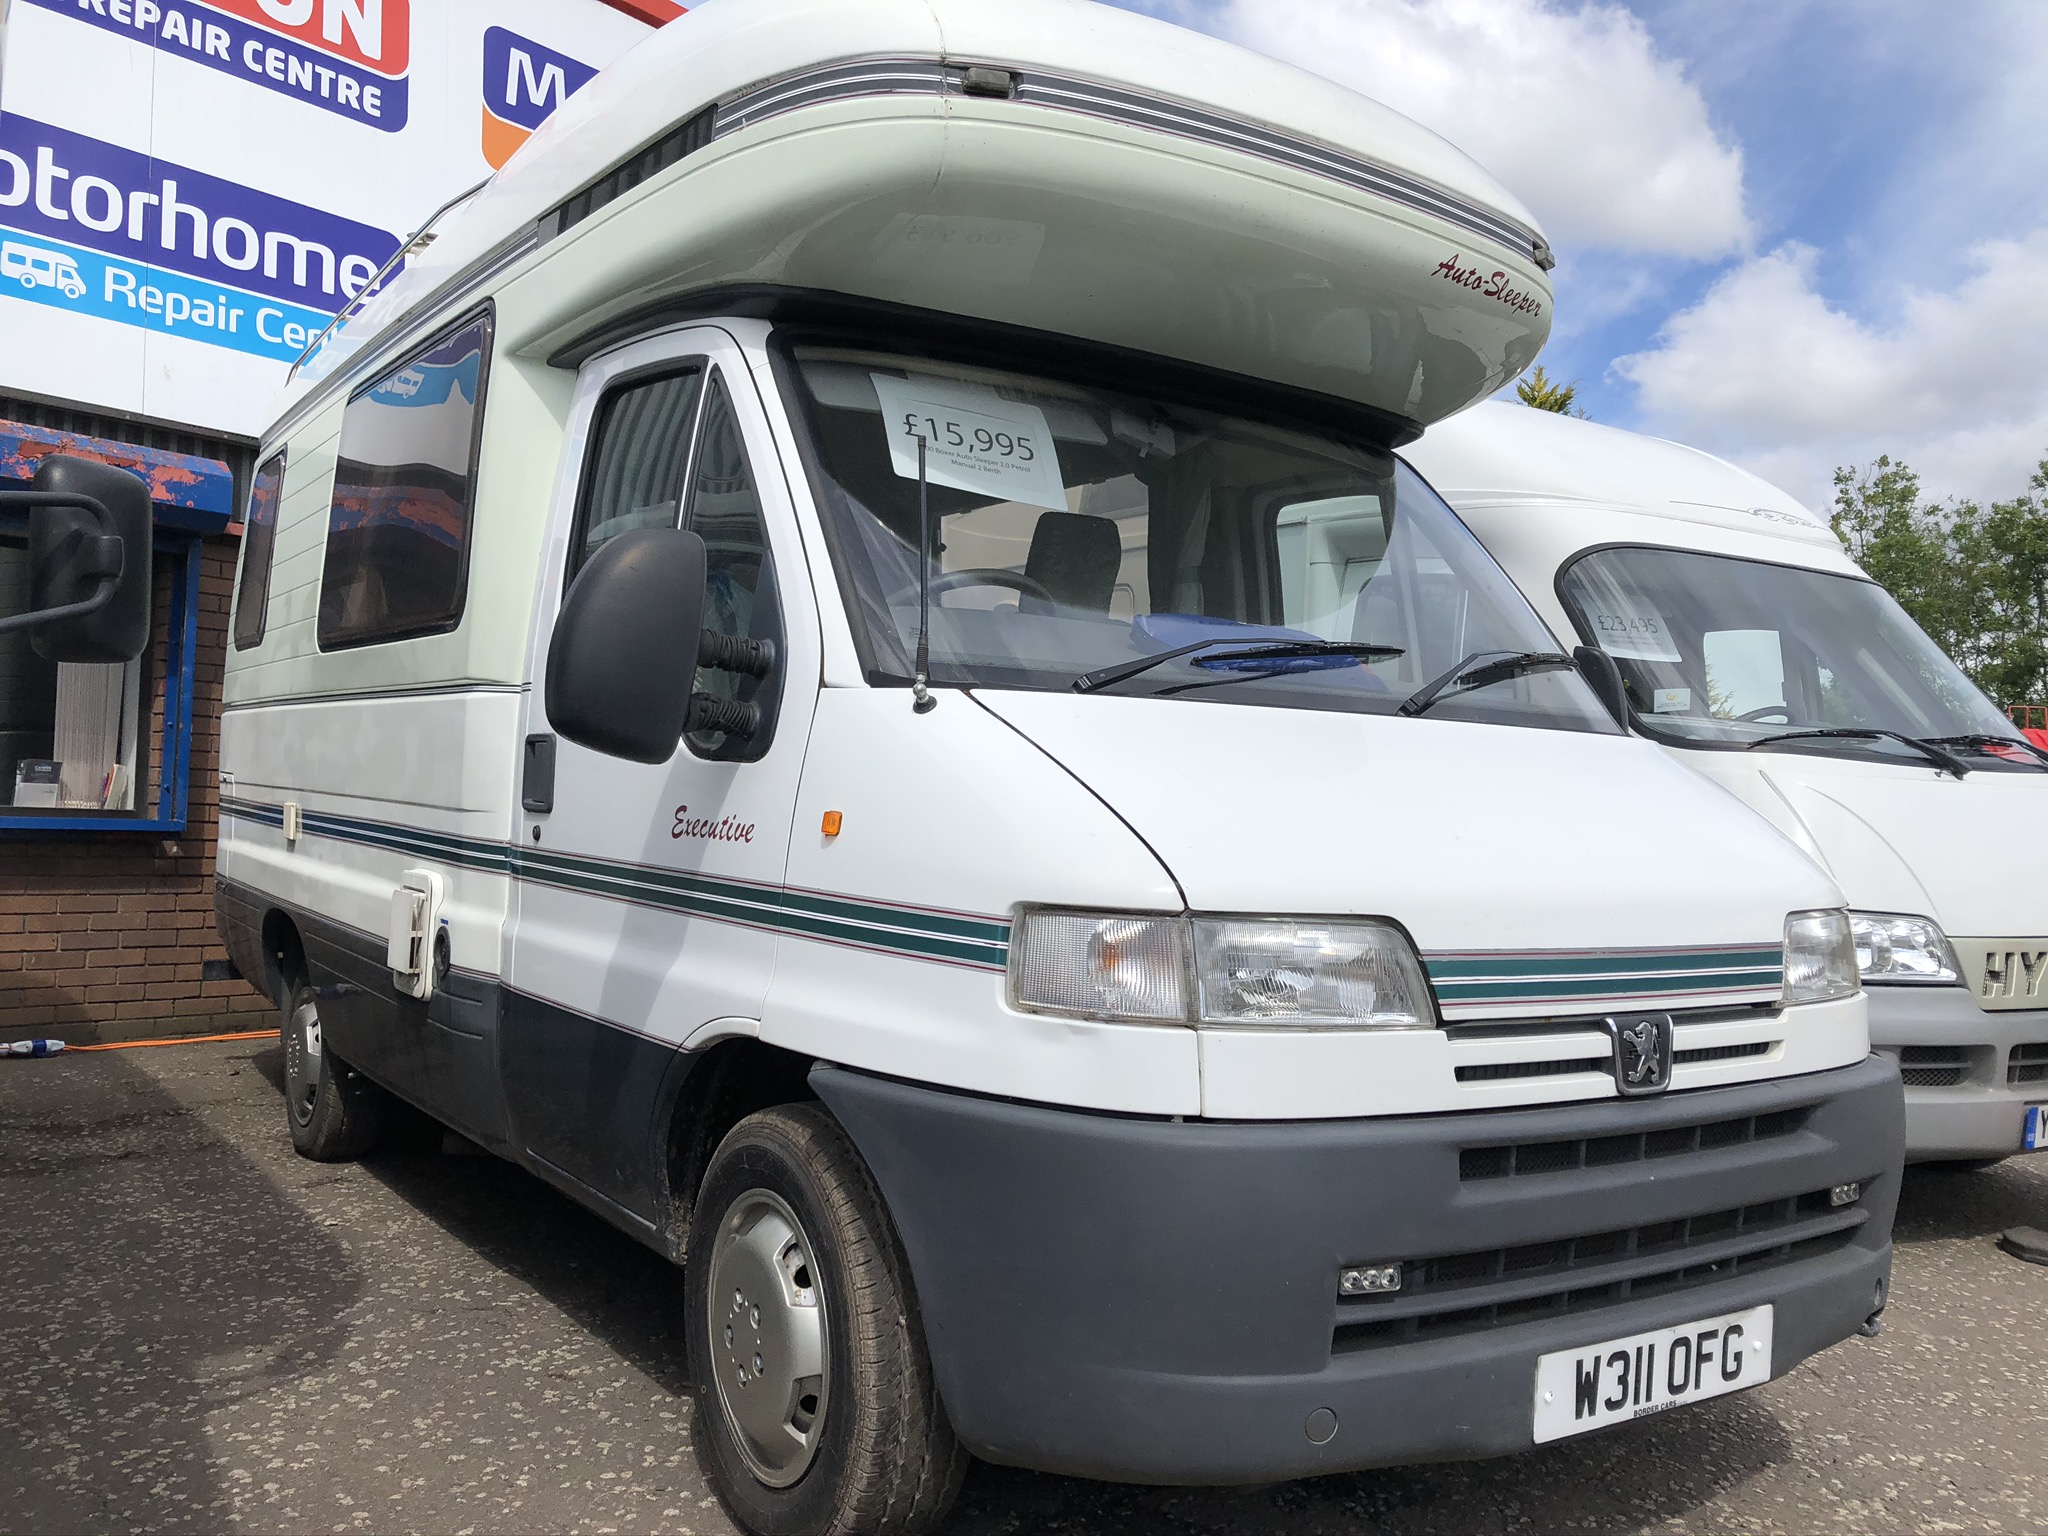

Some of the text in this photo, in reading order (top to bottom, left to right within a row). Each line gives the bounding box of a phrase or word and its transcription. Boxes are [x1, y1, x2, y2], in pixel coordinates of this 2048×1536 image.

[242, 40, 382, 118] CENTRE
[1430, 253, 1542, 317] Auto-Sleeper
[104, 265, 338, 350] Repair Cen
[903, 413, 1035, 461] £15,995
[935, 447, 955, 457] Boxer
[956, 452, 973, 461] Auto
[973, 455, 999, 466] Sleeper
[1000, 461, 1011, 469] 2.0
[1011, 464, 1031, 473] Petrol
[951, 459, 976, 470] Manual
[983, 465, 1002, 475] Berth
[1598, 614, 1659, 634] £23,495
[671, 804, 755, 843] Executive
[1575, 1324, 1744, 1420] W311 OFG
[1633, 1404, 1660, 1417] BORDER
[1660, 1400, 1677, 1411] CARS
